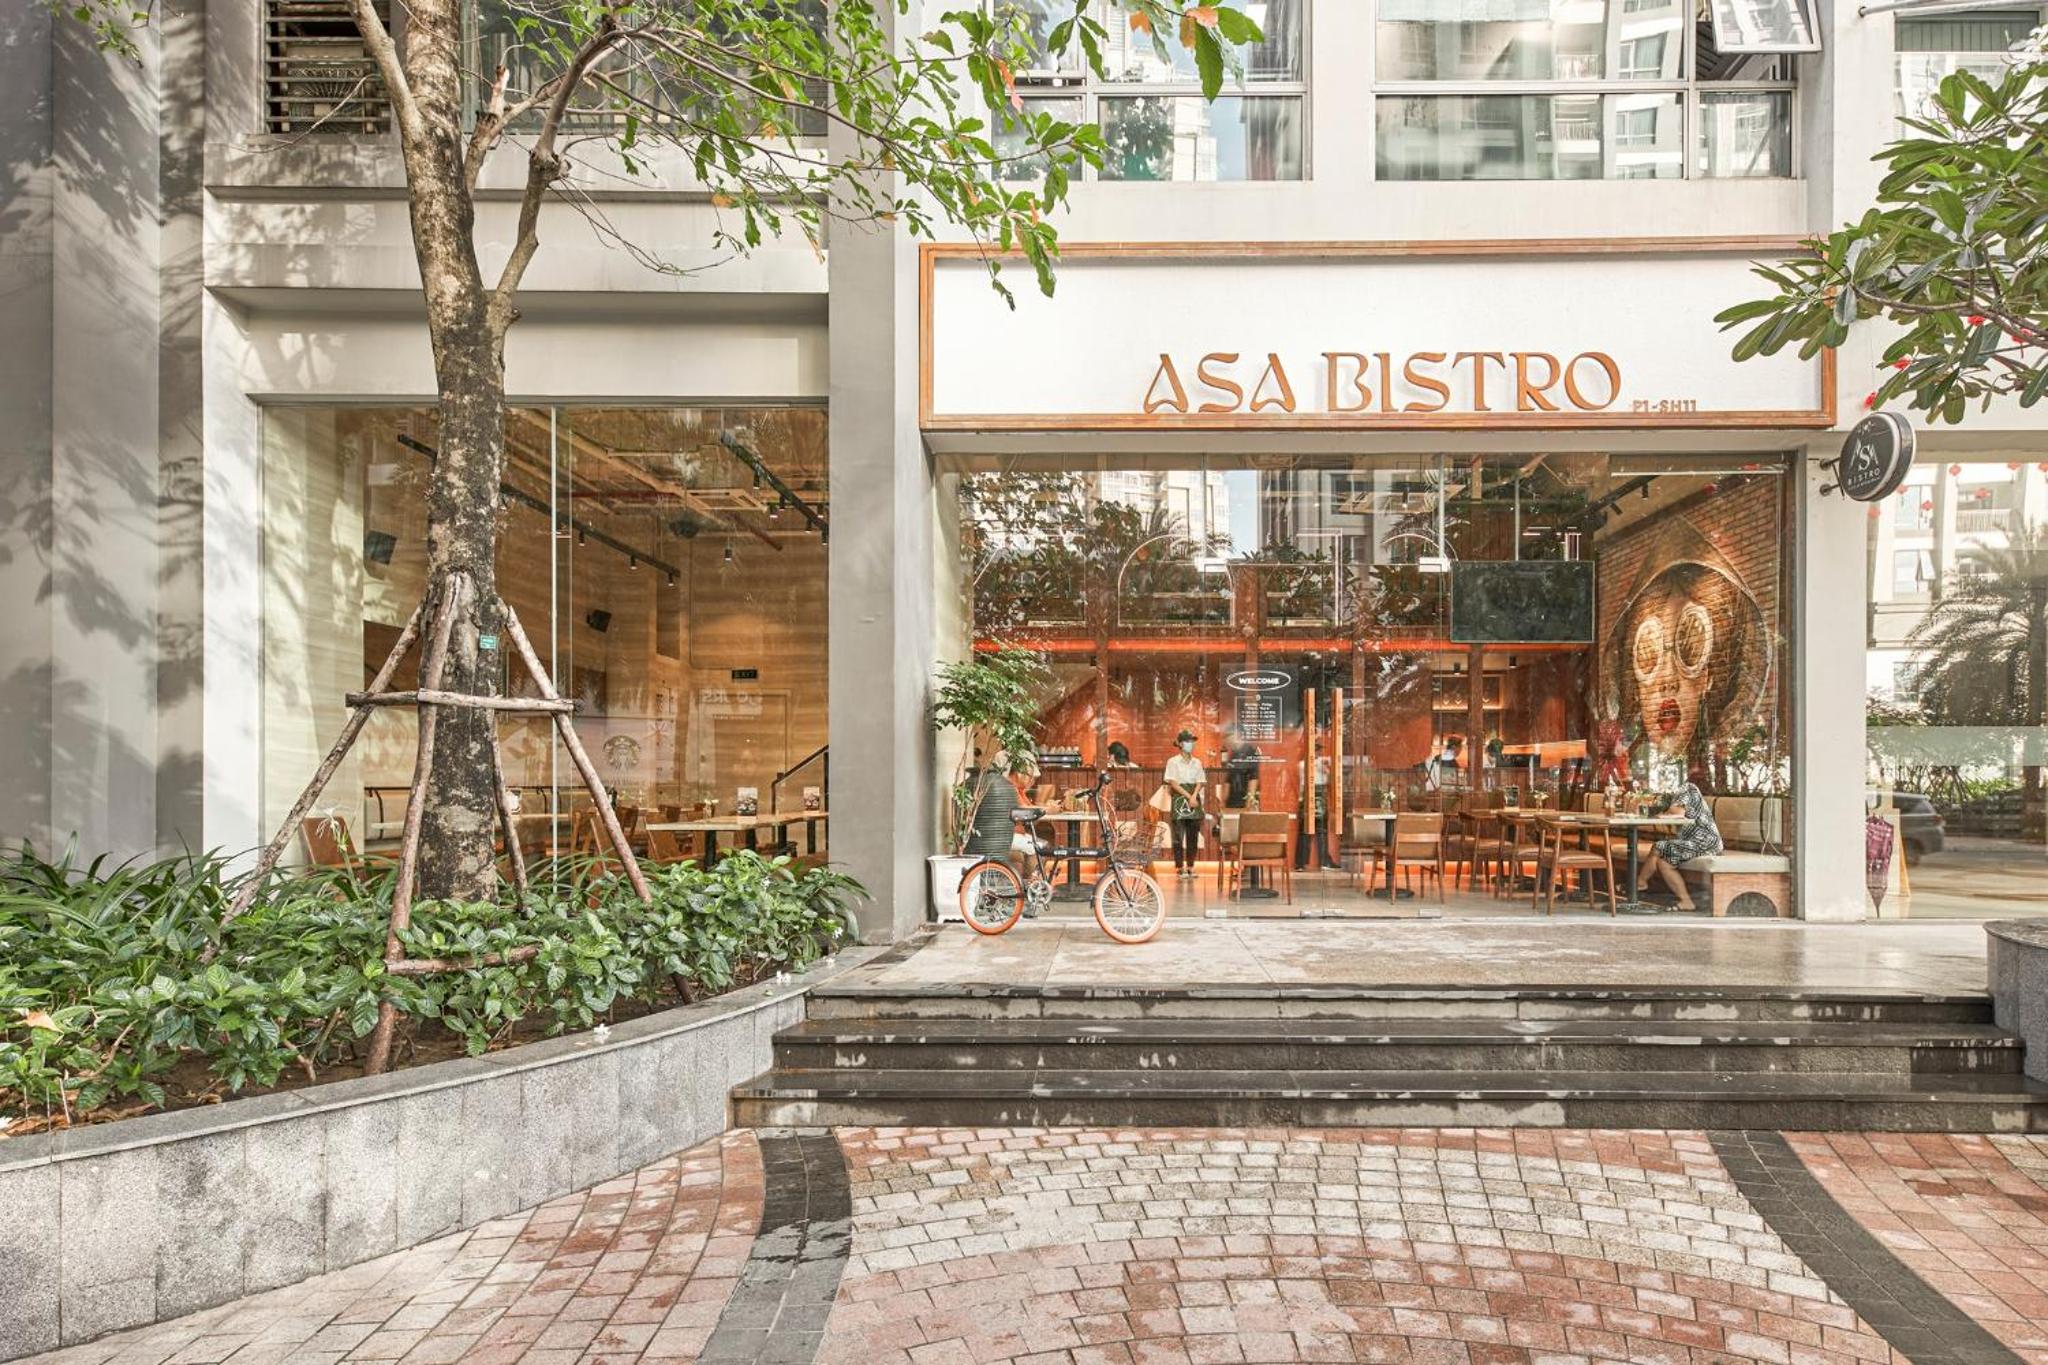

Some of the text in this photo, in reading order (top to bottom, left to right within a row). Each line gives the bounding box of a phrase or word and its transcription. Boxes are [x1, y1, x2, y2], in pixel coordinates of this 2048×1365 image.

[1143, 352, 1622, 413] ASA BISTRO
[1847, 467, 1881, 486] BISTRO
[1239, 677, 1280, 685] WELCOME
